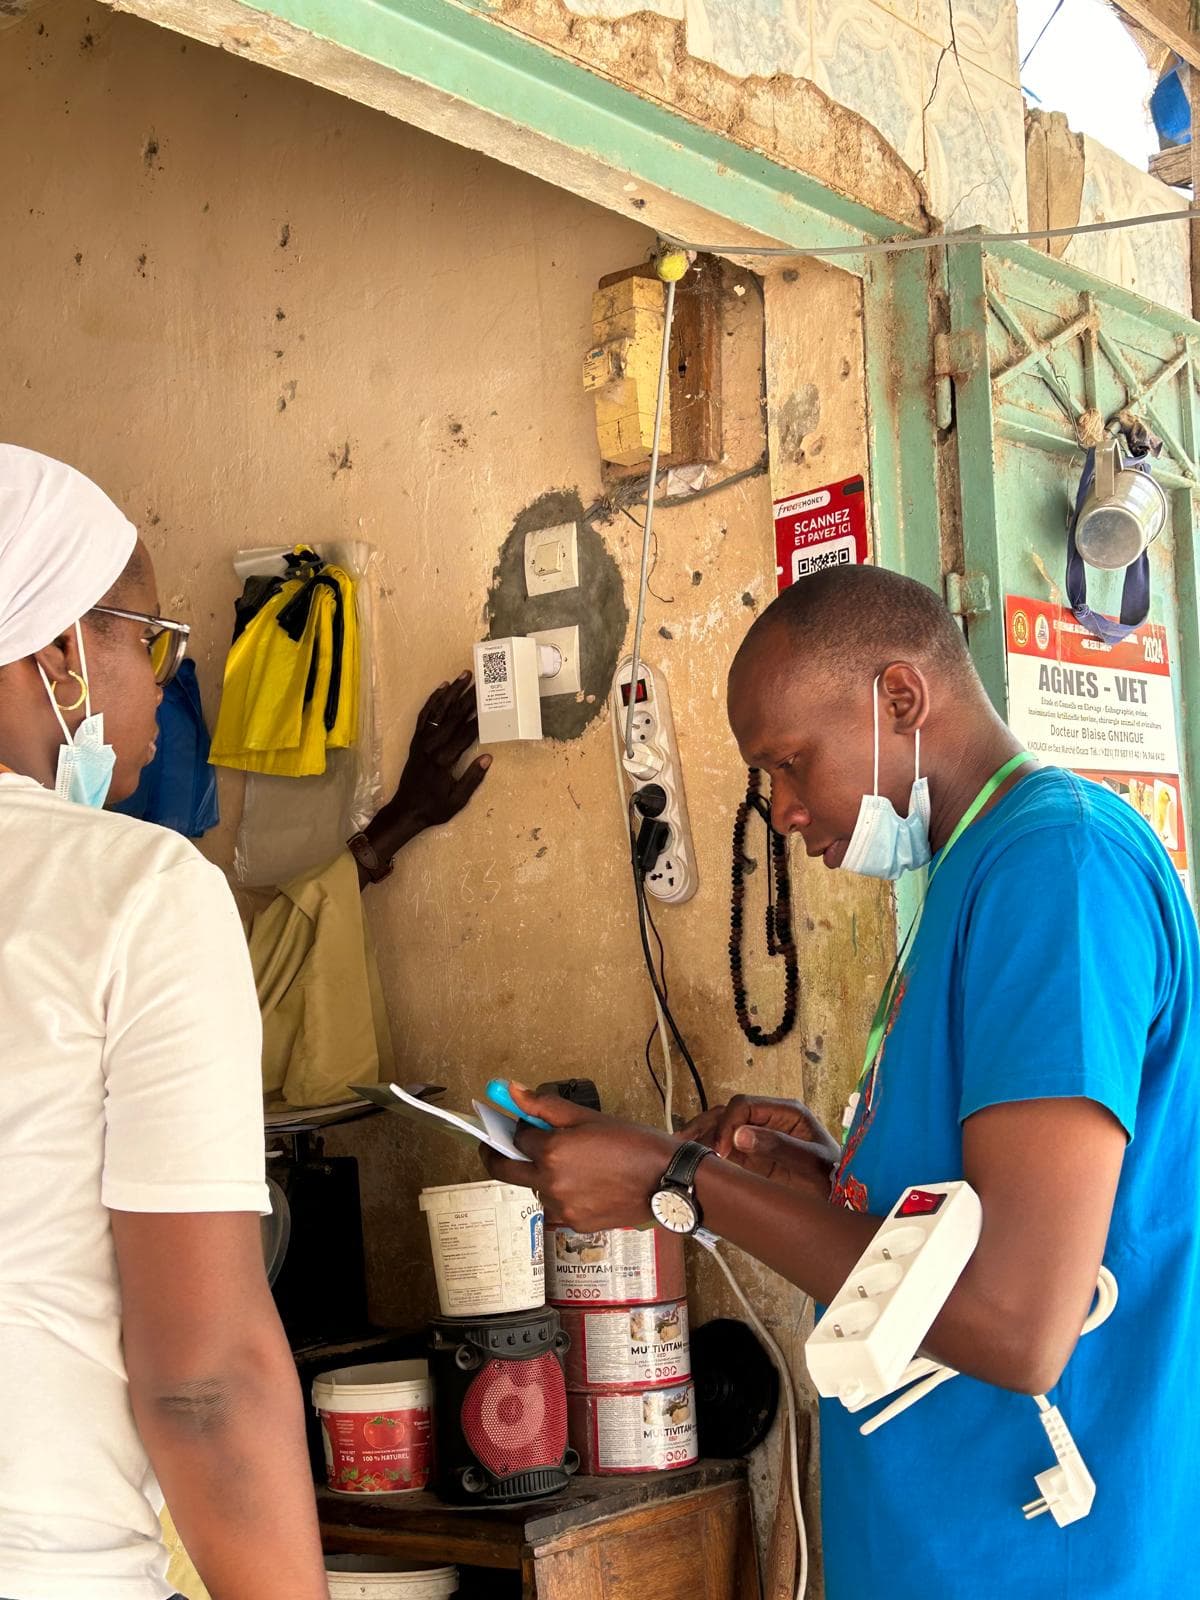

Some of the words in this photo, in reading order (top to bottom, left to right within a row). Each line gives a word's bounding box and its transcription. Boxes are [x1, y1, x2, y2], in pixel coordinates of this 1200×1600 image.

[794, 508, 850, 535] SCANNEZ
[794, 534, 806, 546] ET
[807, 526, 837, 543] PAYEZ
[838, 522, 851, 534] ICI
[1038, 663, 1099, 699] AGNES
[1115, 675, 1148, 704] VET
[1050, 724, 1079, 739] Docteur
[1081, 727, 1106, 741] Blaise
[1108, 730, 1144, 744] GNINGUE
[556, 1264, 613, 1273] MULTIVITAM
[631, 1341, 683, 1355] MUTIVITAM
[381, 1453, 409, 1461] NATUREL
